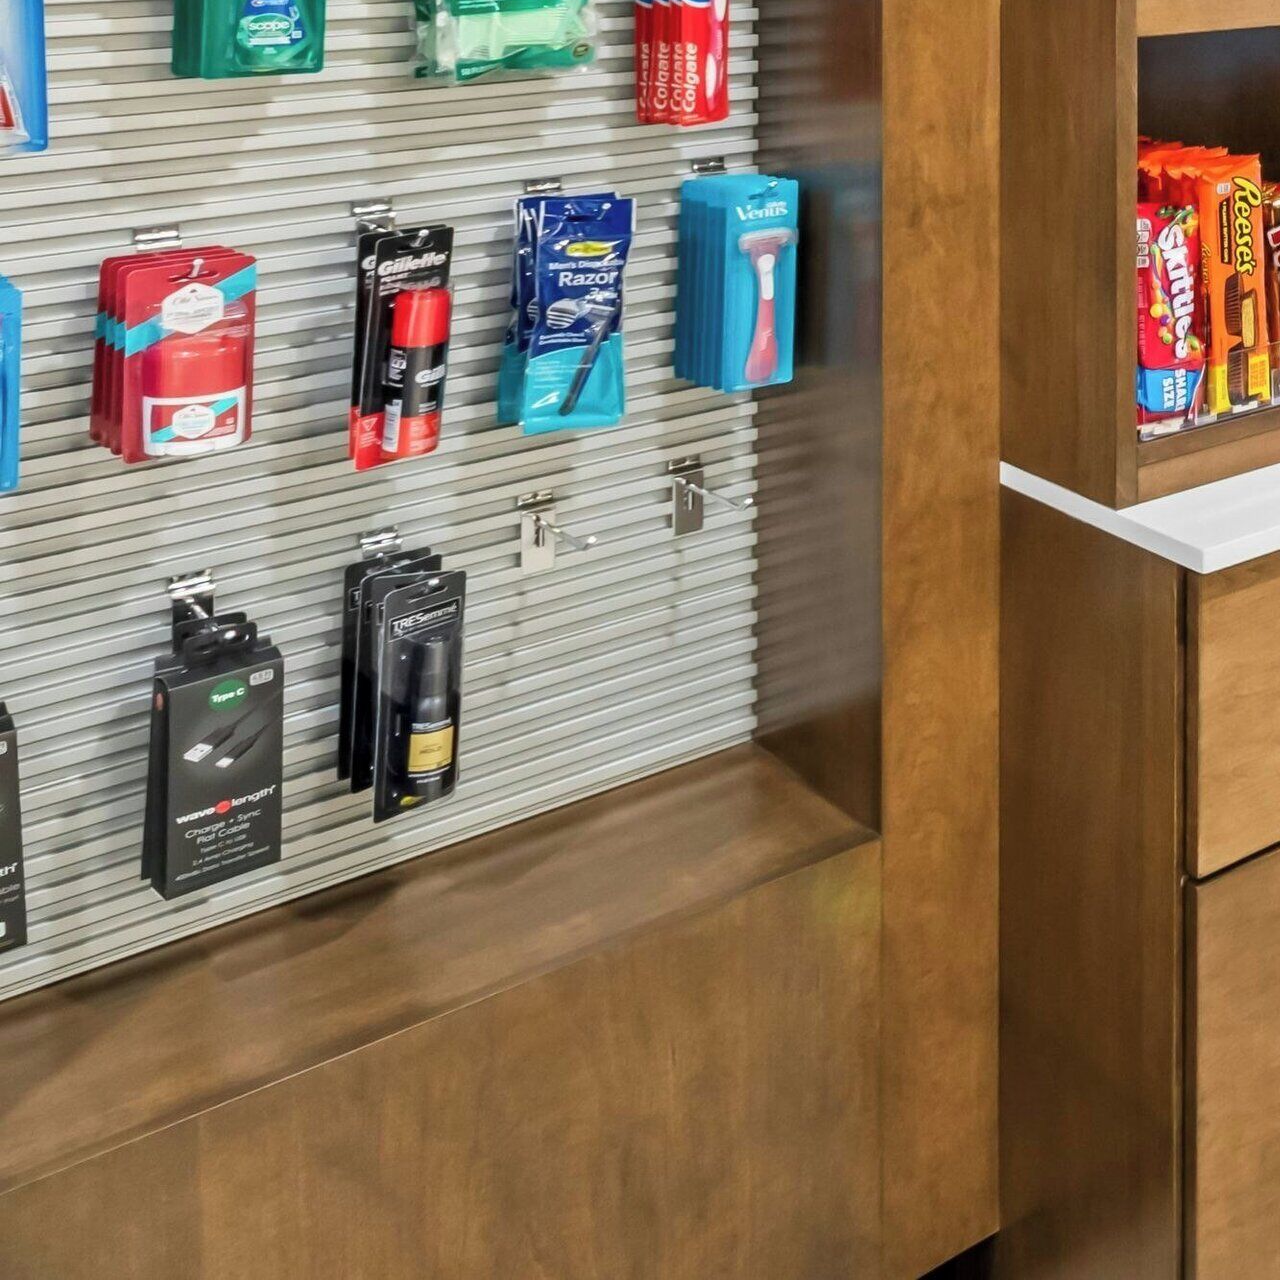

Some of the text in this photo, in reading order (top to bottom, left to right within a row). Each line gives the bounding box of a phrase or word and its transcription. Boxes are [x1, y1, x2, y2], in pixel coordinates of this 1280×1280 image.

[681, 44, 698, 113] Colgate
[735, 203, 789, 221] Venus
[1231, 176, 1263, 276] Reese's
[377, 252, 447, 277] Gillette
[558, 271, 619, 287] Razor
[1158, 224, 1195, 360] Skittles
[1163, 378, 1175, 410] SIZE
[211, 687, 246, 703] Type C
[184, 809, 262, 839] Charge Sync
[196, 822, 251, 845] Flat Cable
